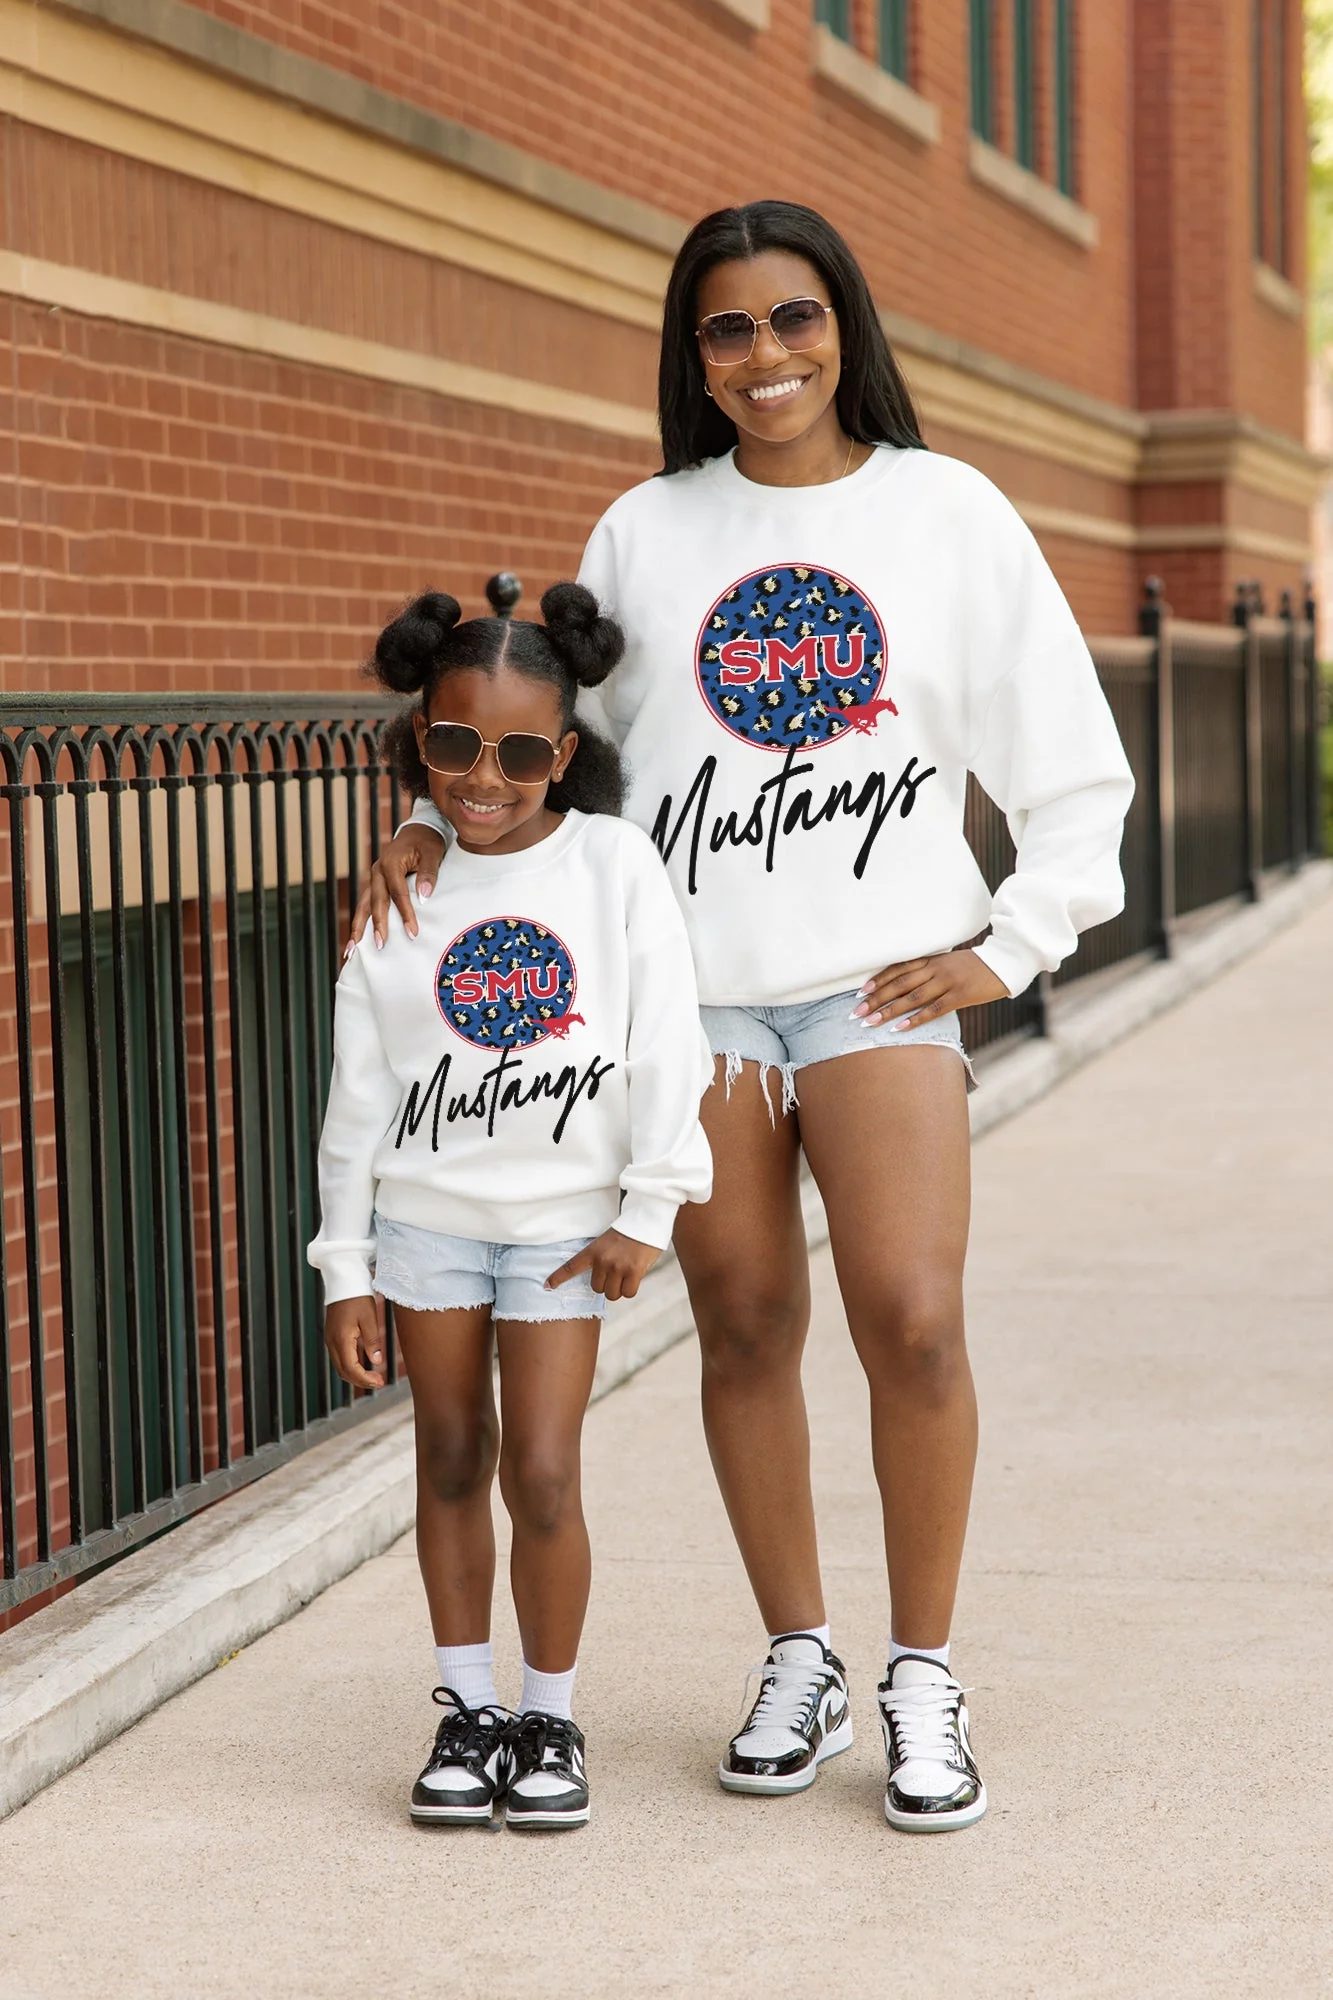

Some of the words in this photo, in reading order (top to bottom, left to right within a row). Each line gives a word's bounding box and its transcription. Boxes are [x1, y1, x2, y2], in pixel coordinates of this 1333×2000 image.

[718, 633, 866, 686] SMU
[651, 743, 937, 895] Mustangs
[452, 966, 560, 1005] SMU
[395, 1047, 615, 1152] Mustangs
